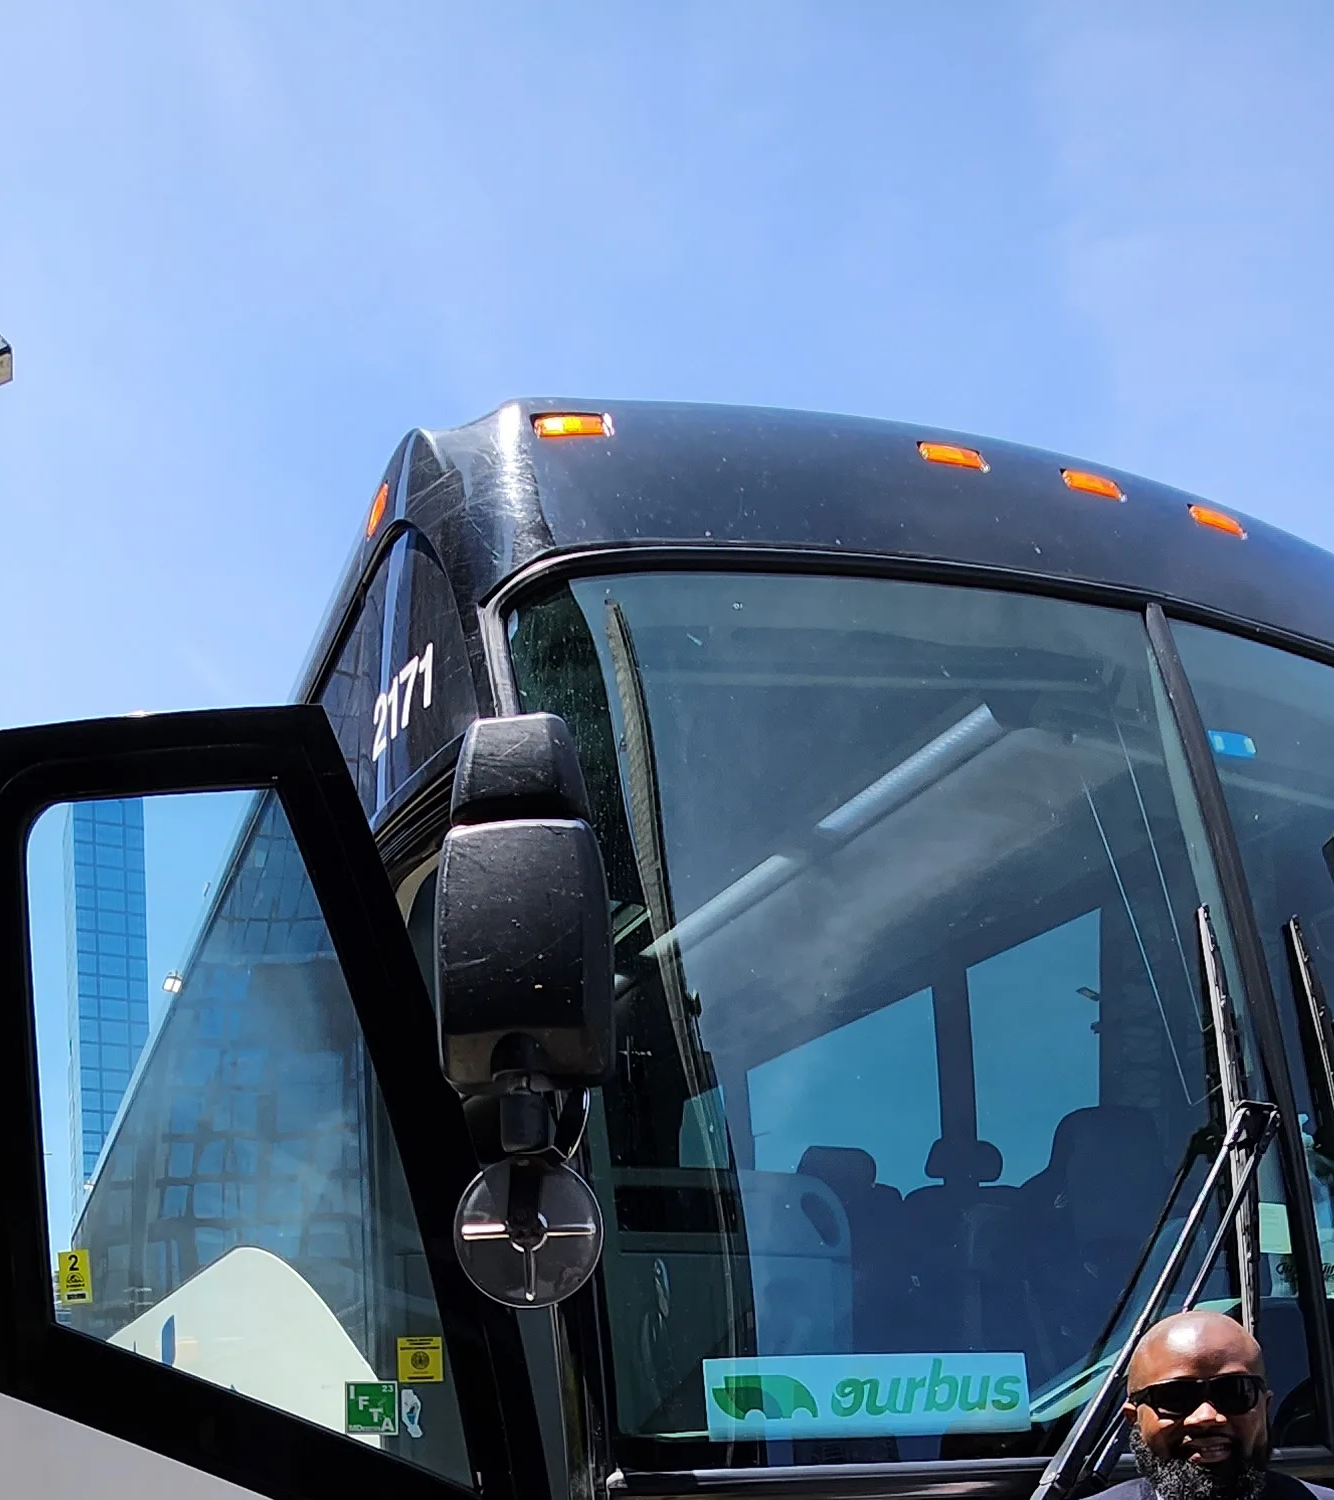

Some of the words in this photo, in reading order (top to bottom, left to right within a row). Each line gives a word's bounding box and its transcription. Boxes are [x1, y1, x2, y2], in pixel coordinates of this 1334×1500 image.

[371, 642, 434, 763] 2171
[68, 1254, 79, 1271] 2
[831, 1358, 1021, 1417] ourbus
